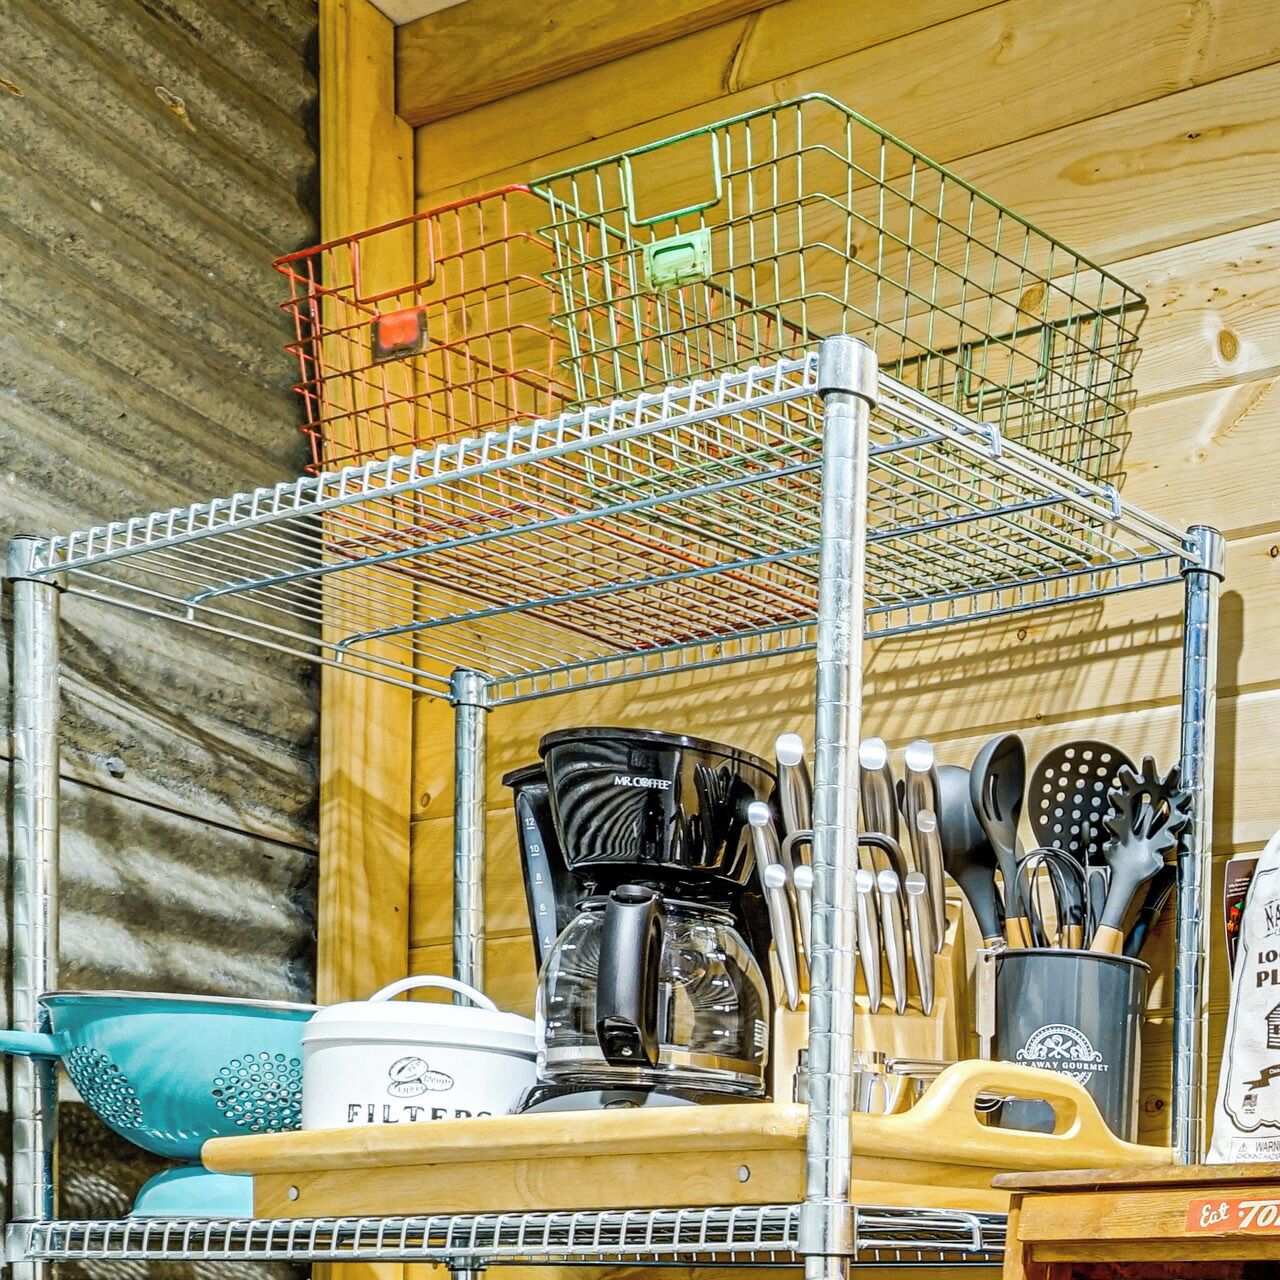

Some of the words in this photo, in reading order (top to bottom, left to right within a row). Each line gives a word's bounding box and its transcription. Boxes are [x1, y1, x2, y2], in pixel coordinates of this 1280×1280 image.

[632, 777, 669, 790] COFFEE
[525, 818, 535, 826] 12
[529, 845, 540, 853] 10
[1061, 1062, 1109, 1072] GOURMET
[1199, 1202, 1229, 1228] Eat
